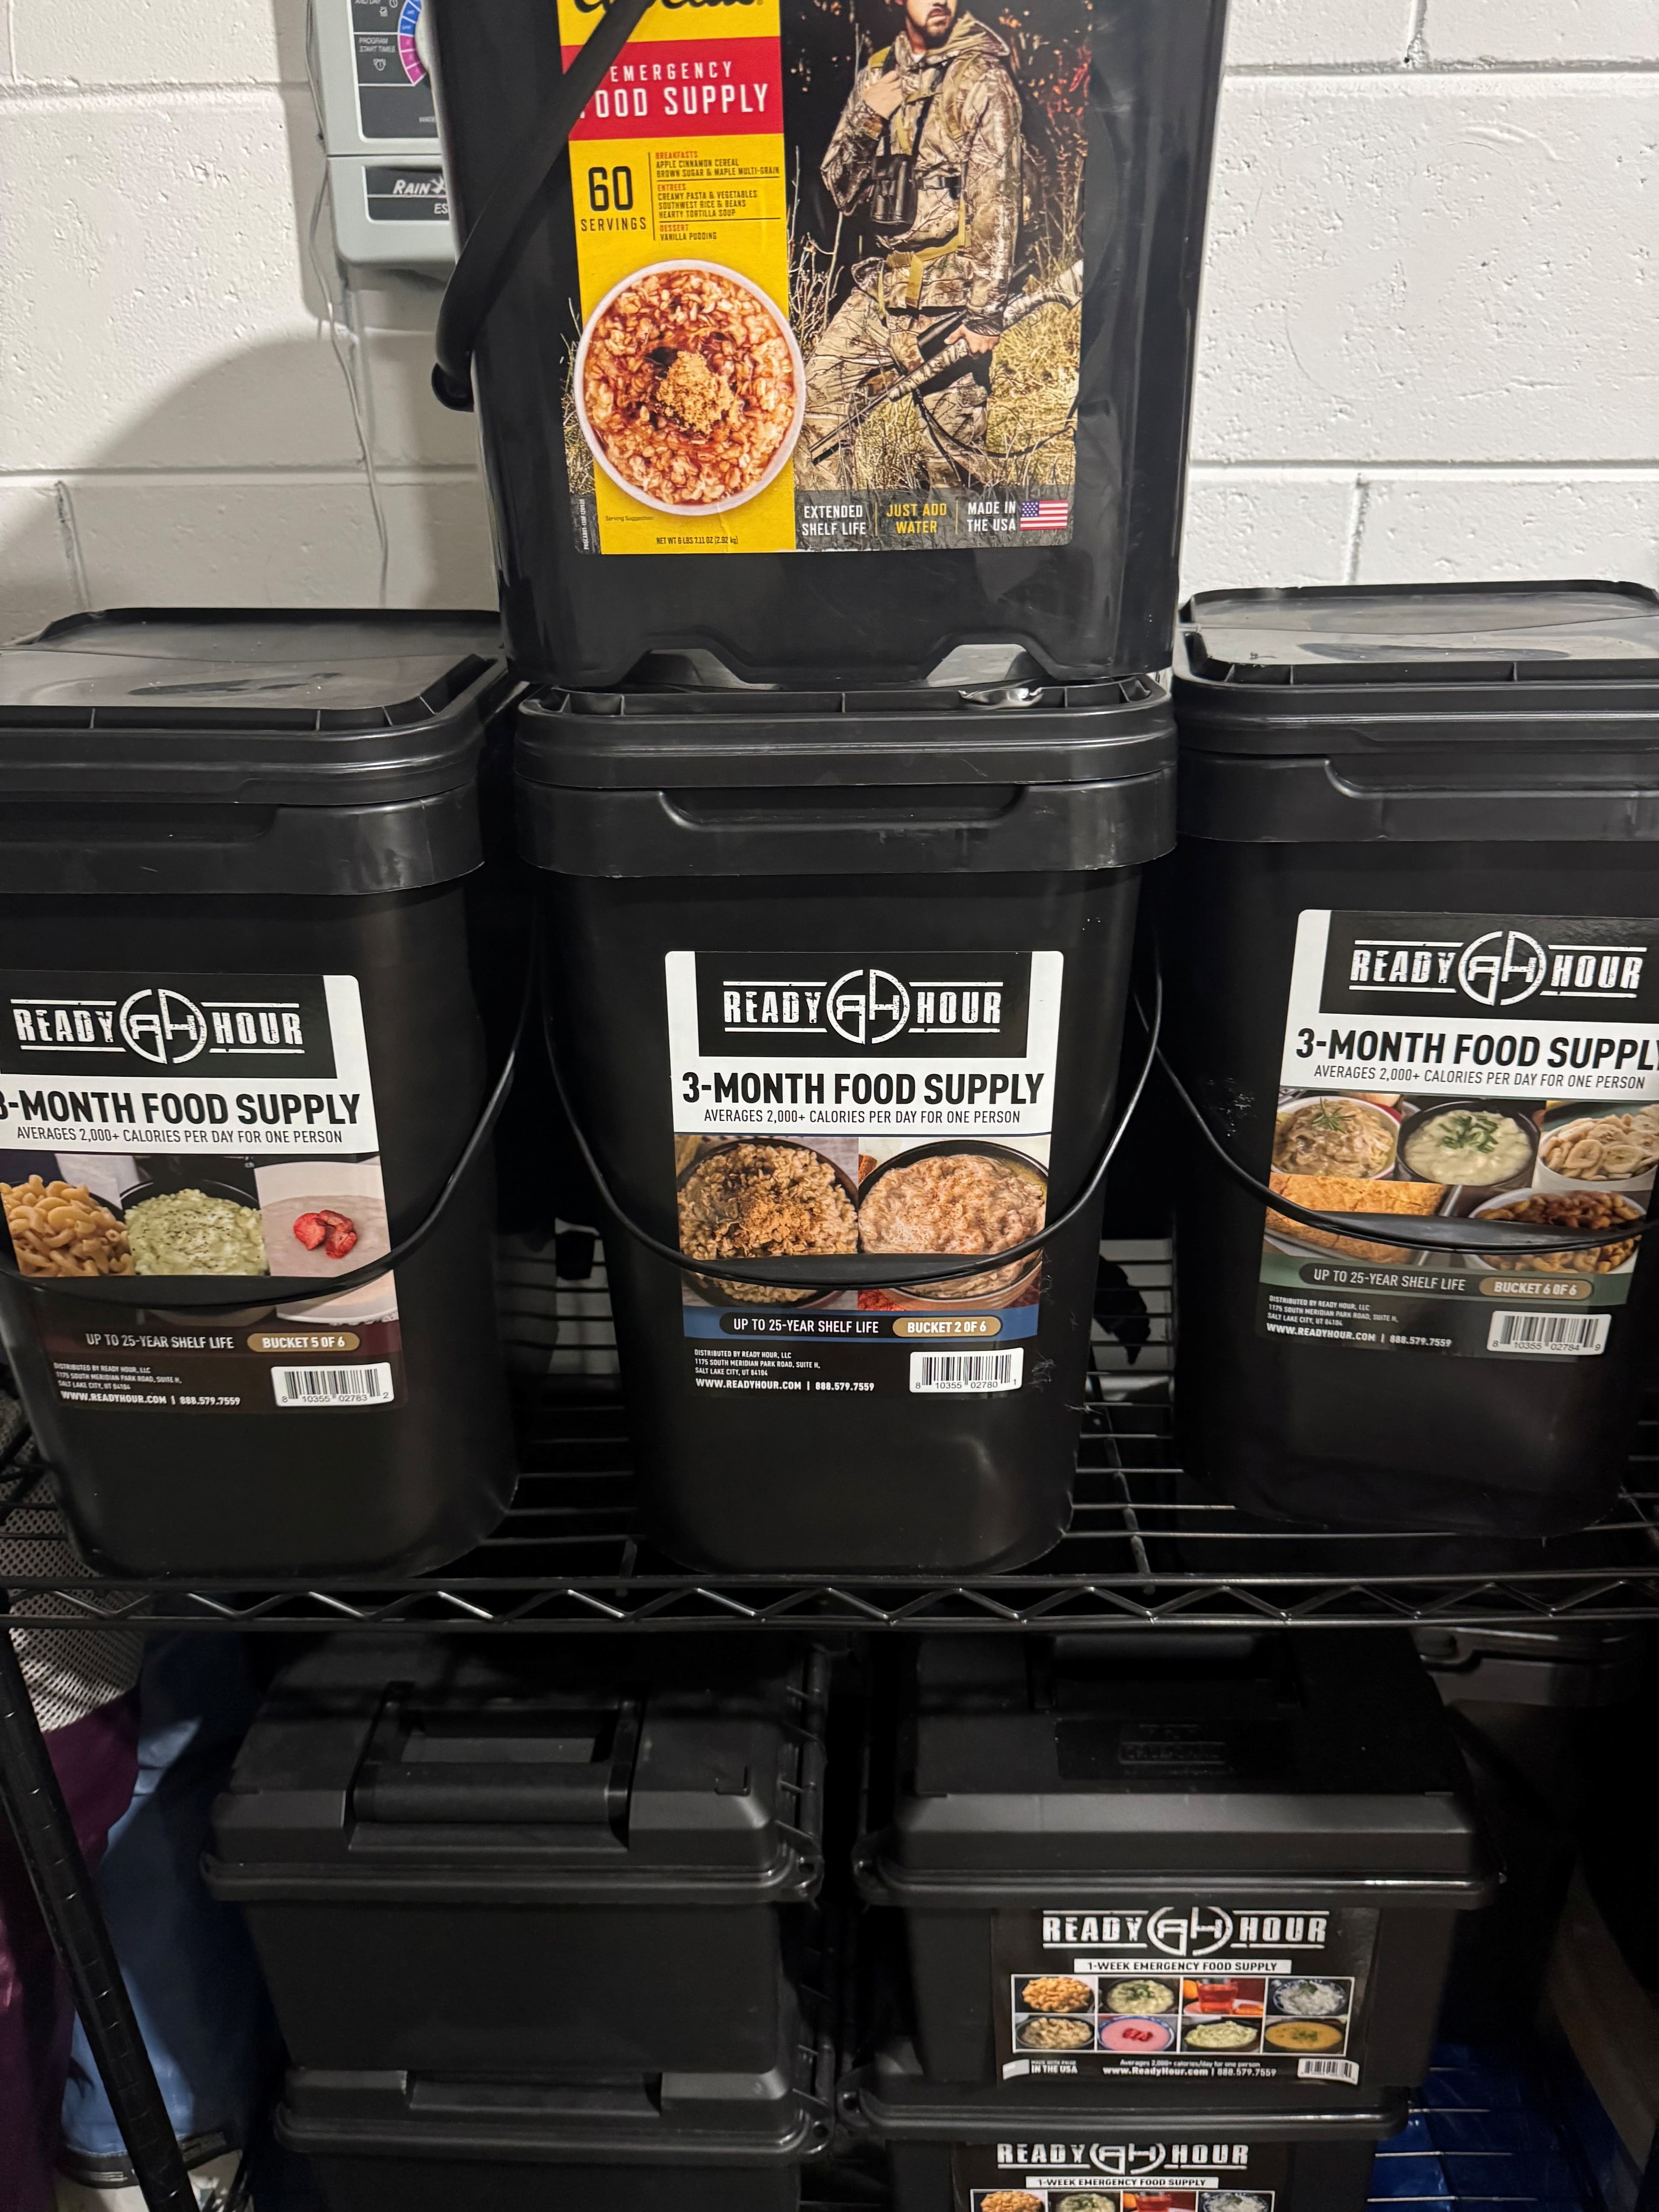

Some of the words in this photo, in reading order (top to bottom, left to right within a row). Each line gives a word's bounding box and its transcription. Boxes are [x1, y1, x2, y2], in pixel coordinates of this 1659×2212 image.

[611, 61, 731, 82] EMERGENCY
[580, 88, 648, 119] OOD
[664, 84, 767, 115] SUPPLY
[588, 166, 633, 211] 60
[582, 217, 646, 232] SERVINGS
[804, 505, 862, 519] EXTENDED
[887, 503, 917, 517] JUST
[923, 503, 947, 515] ADD
[968, 501, 1000, 515] MADE
[1004, 501, 1016, 513] IN
[802, 522, 836, 536] SHELF
[842, 522, 865, 534] LIFE
[896, 521, 937, 534] WATER
[967, 519, 990, 532] THE
[993, 518, 1016, 531] USA
[1350, 950, 1456, 983] READY
[1551, 955, 1642, 989] HOUR
[724, 991, 821, 1023] READY
[917, 992, 1001, 1023] HOUR
[13, 1009, 114, 1042] READY
[212, 1012, 303, 1044] HOUR
[1296, 1028, 1446, 1063] 3-MONTH
[1453, 1034, 1540, 1067] FOOD
[1547, 1037, 1659, 1071] SUPPL
[1314, 1065, 1376, 1079] AVERAGES
[1379, 1068, 1420, 1081] 2,000+
[1424, 1070, 1483, 1084] CALORIES
[1487, 1072, 1510, 1084] PER
[1514, 1073, 1537, 1086] DAY
[1540, 1074, 1564, 1087] FOR
[1568, 1075, 1592, 1087] ONE
[1596, 1076, 1645, 1089] PERSON
[682, 1072, 824, 1104] 3-MONTH
[835, 1074, 915, 1104] FOOD
[924, 1073, 1045, 1104] SUPPLY
[142, 1093, 228, 1124] FOOD
[236, 1093, 360, 1124] SUPPLY
[704, 1109, 762, 1122] AVERAGES
[767, 1110, 805, 1123] 2,000+
[810, 1111, 864, 1123] CALORIES
[870, 1111, 890, 1123] PER
[896, 1111, 917, 1123] DAY
[921, 1111, 942, 1123] FOR
[947, 1111, 969, 1123] ONE
[974, 1111, 1020, 1123] PERSON
[18, 1127, 76, 1140] AVERAGES
[79, 1129, 119, 1142] 2,000+
[124, 1130, 180, 1142] CALORIES
[185, 1131, 207, 1142] PER
[212, 1130, 234, 1142] DAY
[238, 1131, 260, 1142] FOR
[266, 1131, 289, 1142] ONE
[294, 1131, 342, 1143] PERSON
[1314, 1269, 1330, 1281] UP
[1333, 1270, 1347, 1282] TO
[1351, 1271, 1398, 1286] 25-YEAR
[1401, 1275, 1438, 1290] SHELF
[1441, 1278, 1466, 1291] LIFE
[1494, 1282, 1542, 1294] BUCKET
[1543, 1284, 1550, 1294] 6
[1553, 1284, 1567, 1295] OF
[1570, 1285, 1577, 1295] 6
[734, 1318, 748, 1330] UP
[752, 1319, 765, 1331] TO
[769, 1319, 814, 1332] 25-YEAR
[818, 1321, 852, 1332] SHELF
[856, 1321, 879, 1333] LIFE
[908, 1322, 952, 1333] BUCKET
[955, 1322, 961, 1332] 2
[964, 1322, 977, 1332] OF
[980, 1321, 986, 1332] 6
[86, 1333, 101, 1345] UP
[104, 1334, 119, 1345] TO
[122, 1335, 168, 1348] 25-YEAR
[172, 1336, 206, 1349] SHELF
[210, 1337, 234, 1349] LIFE
[263, 1337, 308, 1348] BUCKET
[311, 1337, 318, 1348] 5
[321, 1337, 334, 1347] OF
[338, 1336, 345, 1347] 6
[696, 1378, 801, 1390] WWW.READYHOUR.COM
[815, 1382, 874, 1391] 888.579.7559
[1043, 1916, 1143, 1942] READY
[1239, 1917, 1327, 1942] HOUR
[1088, 1961, 1129, 1971] 1-WEEK
[1133, 1961, 1199, 1971] EMERGENCY
[1203, 1961, 1231, 1971] FOOD
[1235, 1962, 1277, 1971] SUPPLY
[997, 2143, 1085, 2164] READY
[1173, 2144, 1249, 2164] HOUR
